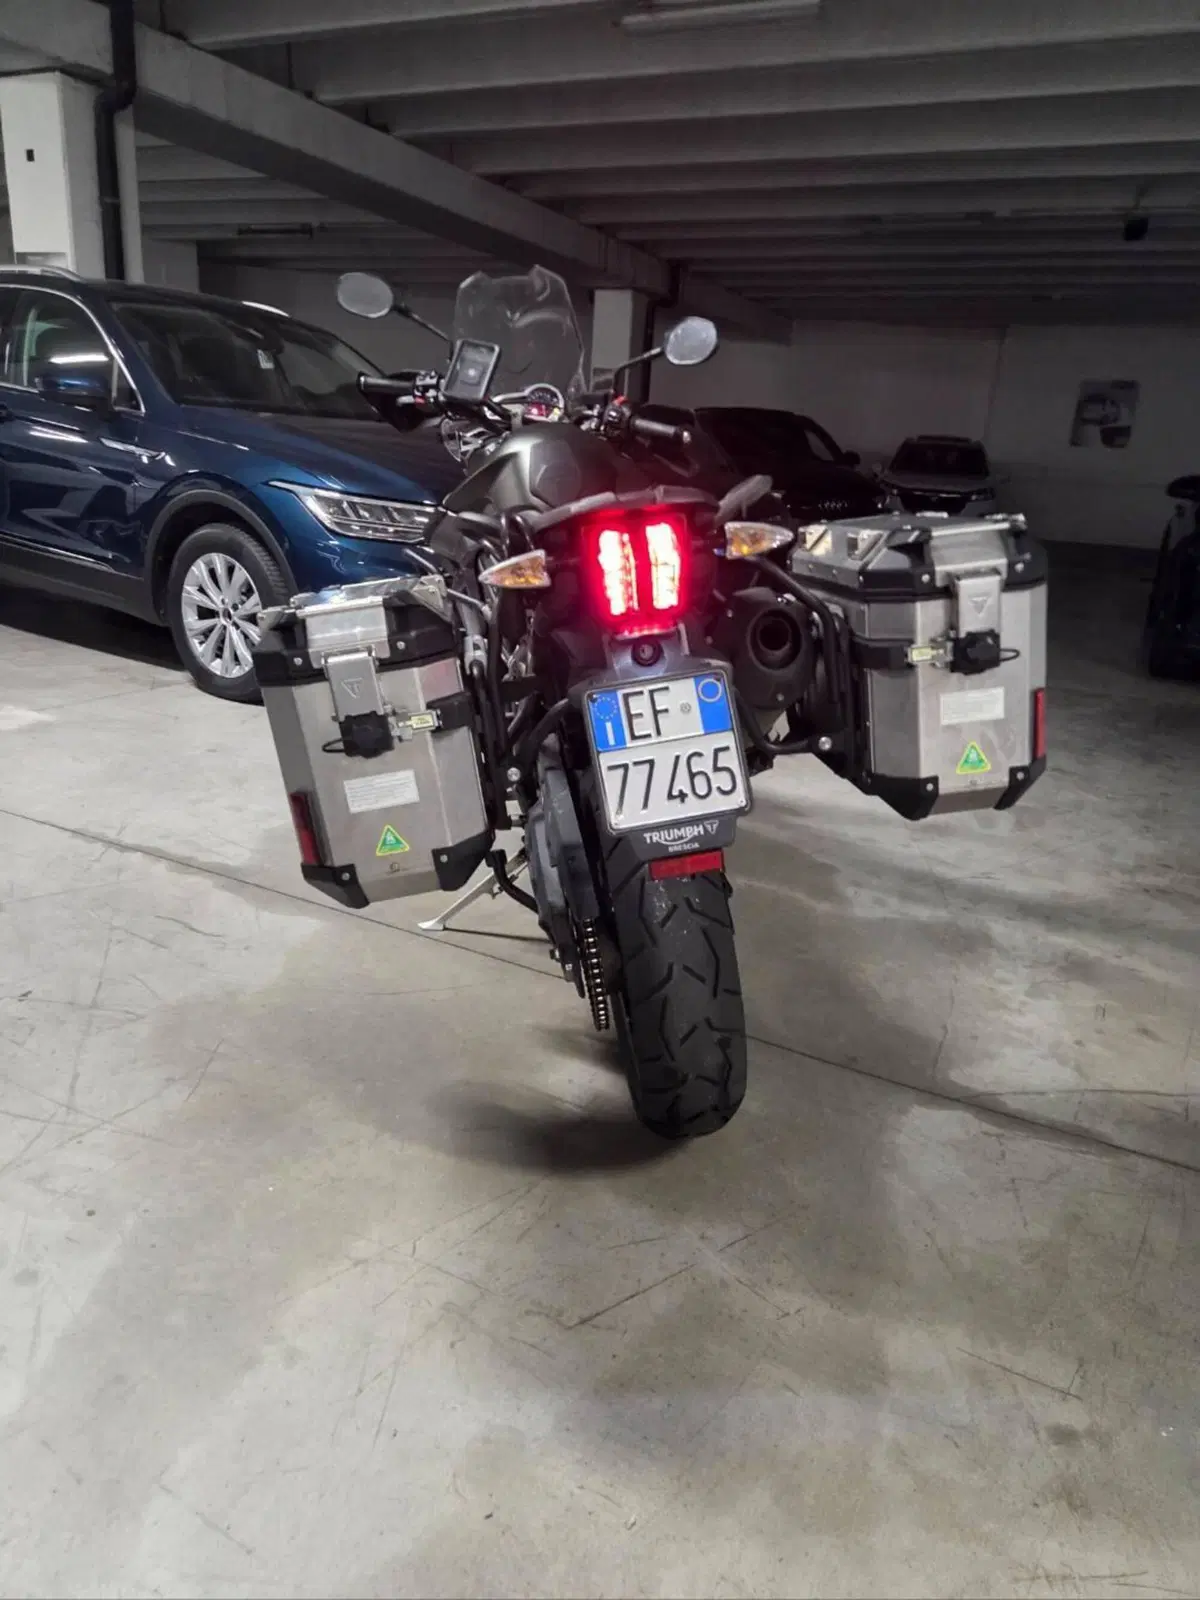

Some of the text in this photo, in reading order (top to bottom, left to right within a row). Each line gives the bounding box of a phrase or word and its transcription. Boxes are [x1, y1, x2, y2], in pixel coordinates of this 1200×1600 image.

[623, 686, 670, 740] EF
[605, 721, 616, 745] I
[607, 746, 737, 815] 77465
[643, 824, 704, 844] TRIUMPH
[668, 842, 700, 852] BRESCIA
